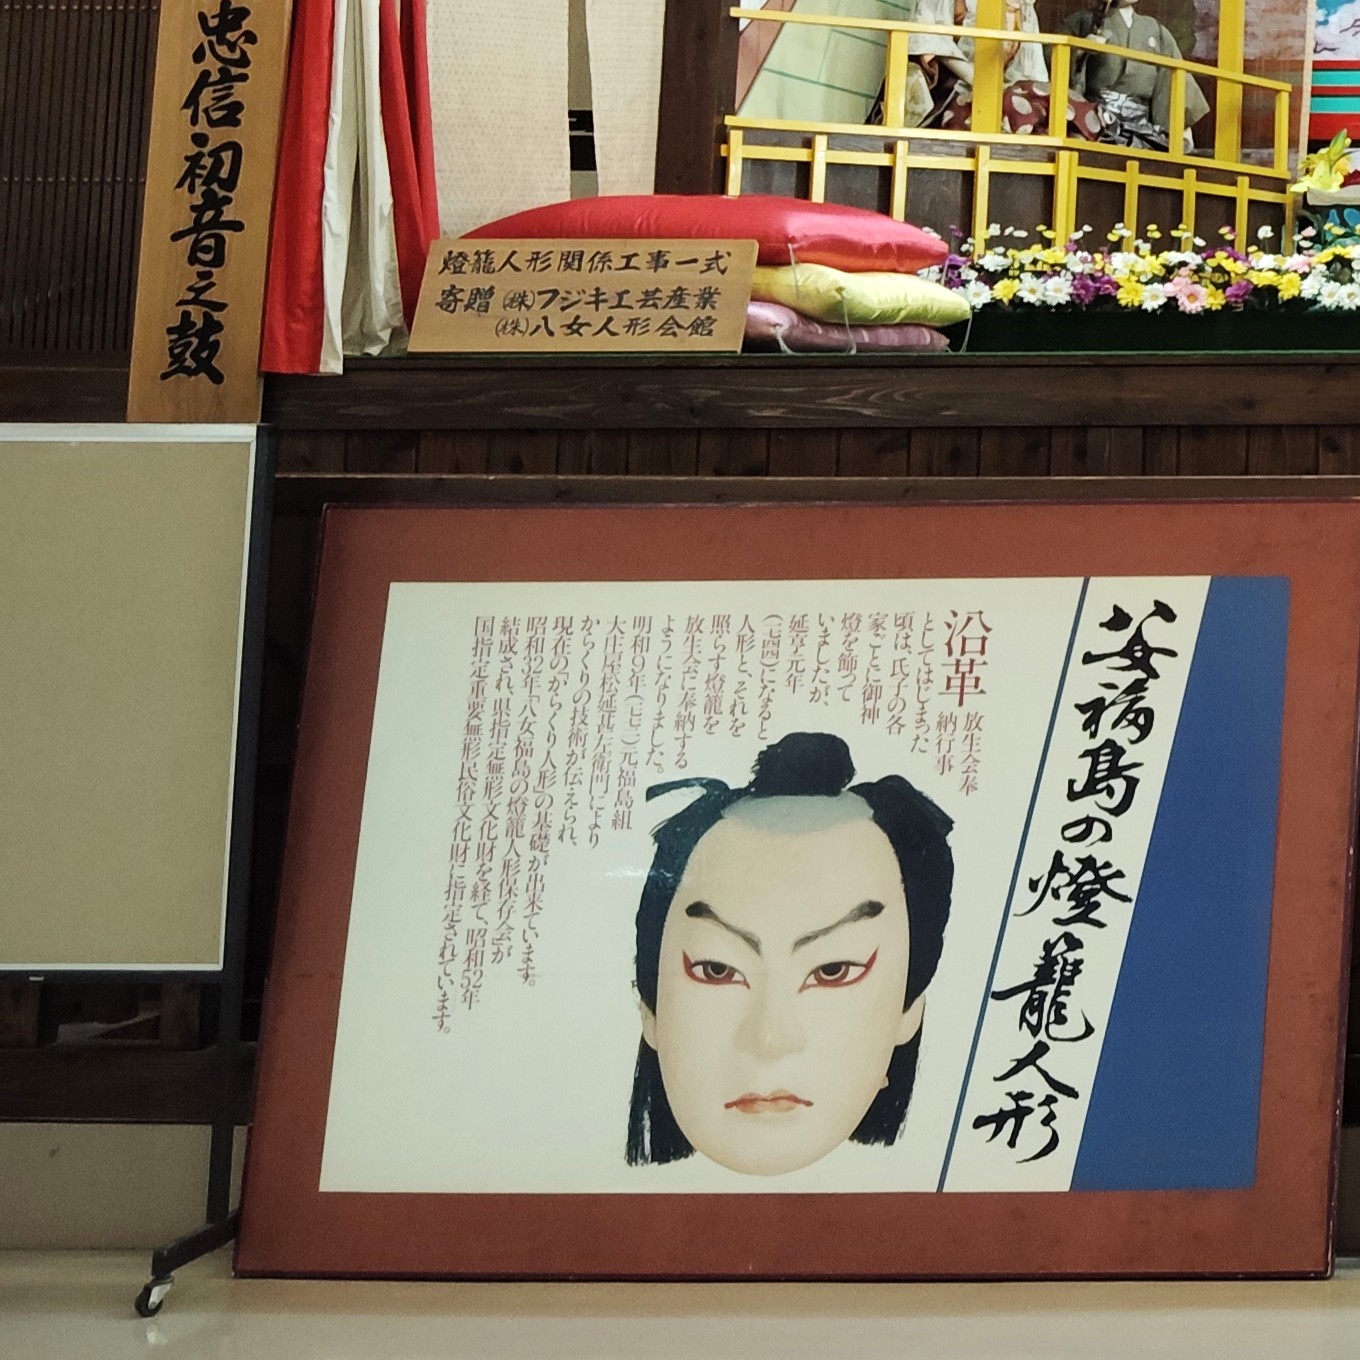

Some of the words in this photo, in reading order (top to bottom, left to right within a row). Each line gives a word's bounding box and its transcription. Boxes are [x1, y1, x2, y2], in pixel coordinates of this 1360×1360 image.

[435, 286, 495, 313] 寄贈
[438, 249, 732, 276] 燈籠人形関係工事一式
[646, 614, 675, 774] ようになりました。
[674, 614, 704, 770] 放生会に奉納する
[703, 614, 731, 736] 照らす燈籠を
[729, 614, 755, 738] 人形と、それを
[809, 612, 836, 707] いましたが、
[837, 612, 862, 702] 燈を飾って
[861, 611, 888, 725] 家ごとに御神
[885, 612, 915, 736] 頃は、氏子の各
[911, 612, 936, 754] としてはじまった
[938, 609, 993, 708] 沿革
[558, 615, 600, 846] からくりの技術が伝えられ、
[934, 711, 957, 776] 納行事
[958, 711, 984, 797] 放生会奉
